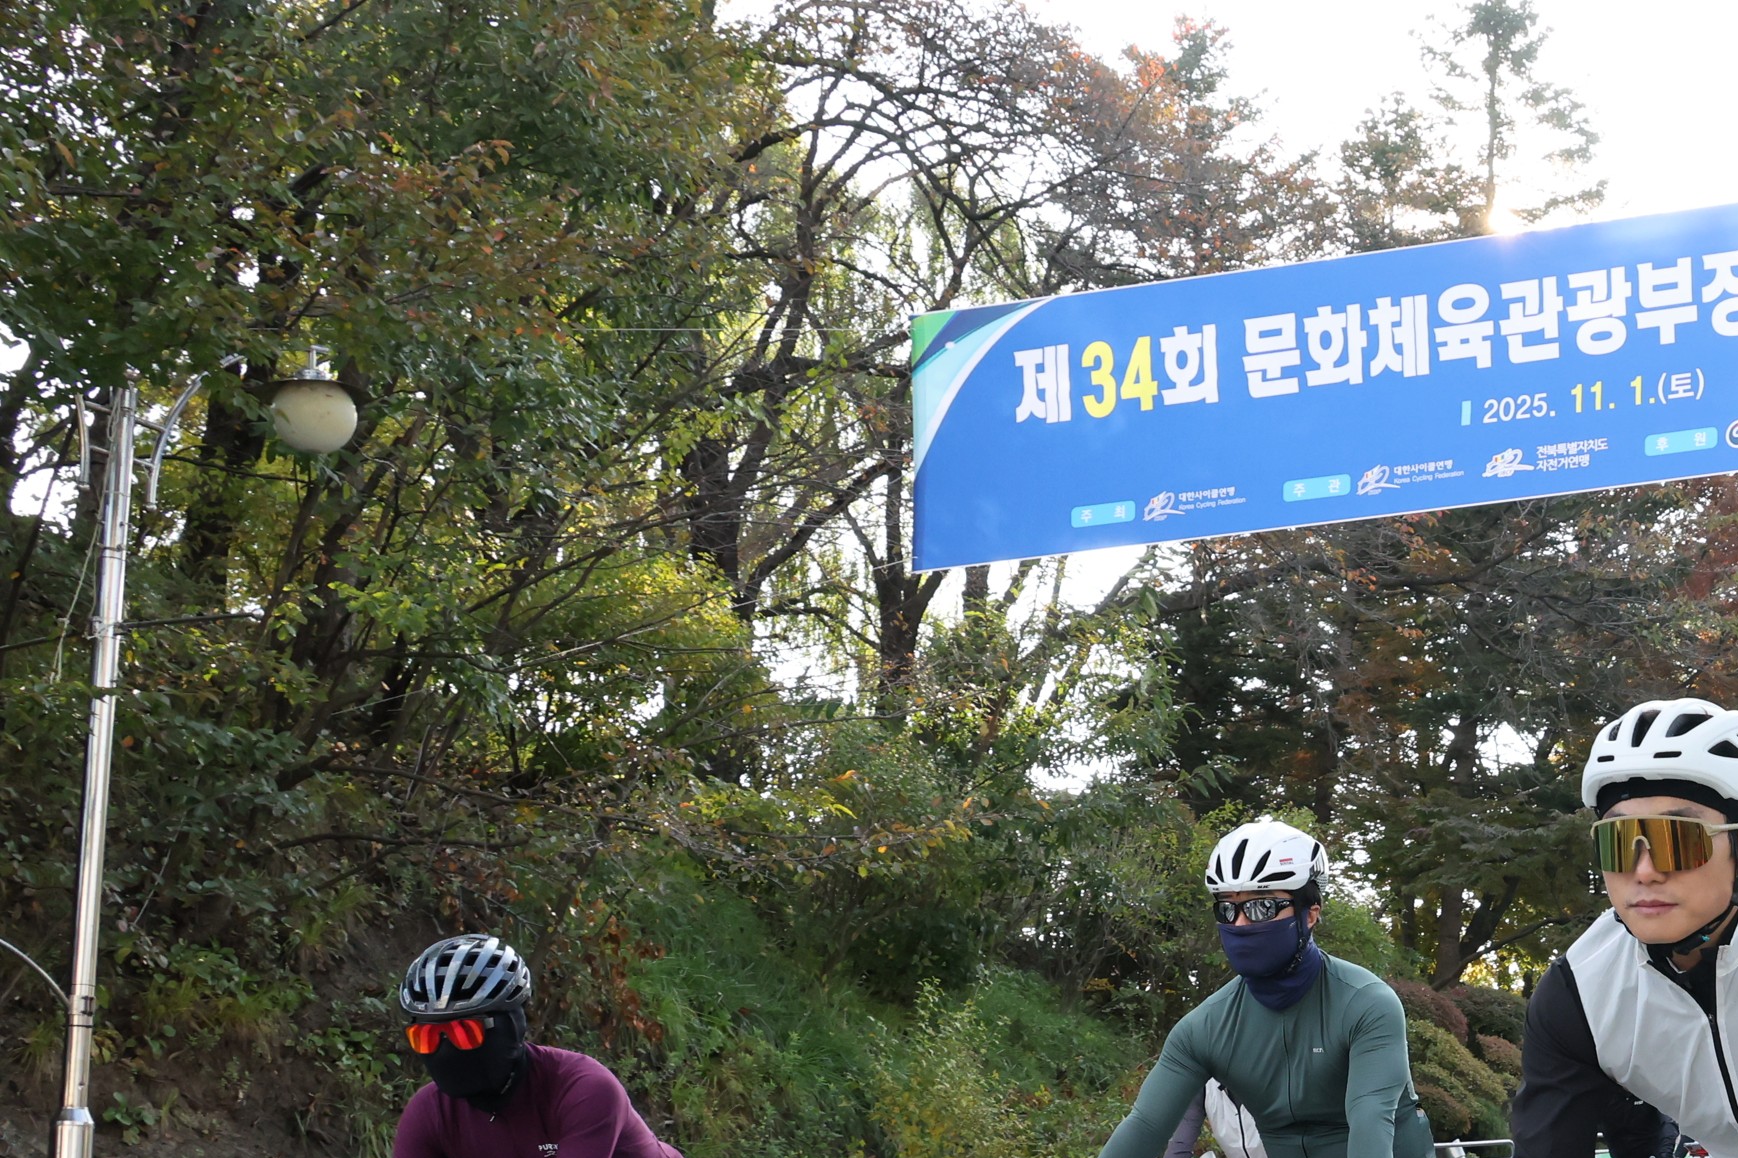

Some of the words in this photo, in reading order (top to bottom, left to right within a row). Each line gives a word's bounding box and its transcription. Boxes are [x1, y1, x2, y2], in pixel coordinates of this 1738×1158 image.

[1014, 322, 1219, 424] 제34회
[1483, 392, 1556, 424] 2025.
[1570, 383, 1616, 412] 11.
[1629, 367, 1705, 405] 1.(토)
[1536, 437, 1609, 459] 전북특별자치도
[1393, 458, 1454, 476] 대한사이클연맹
[1536, 454, 1591, 473] 자전거연맹
[1178, 485, 1236, 502] 대한사이클연맹
